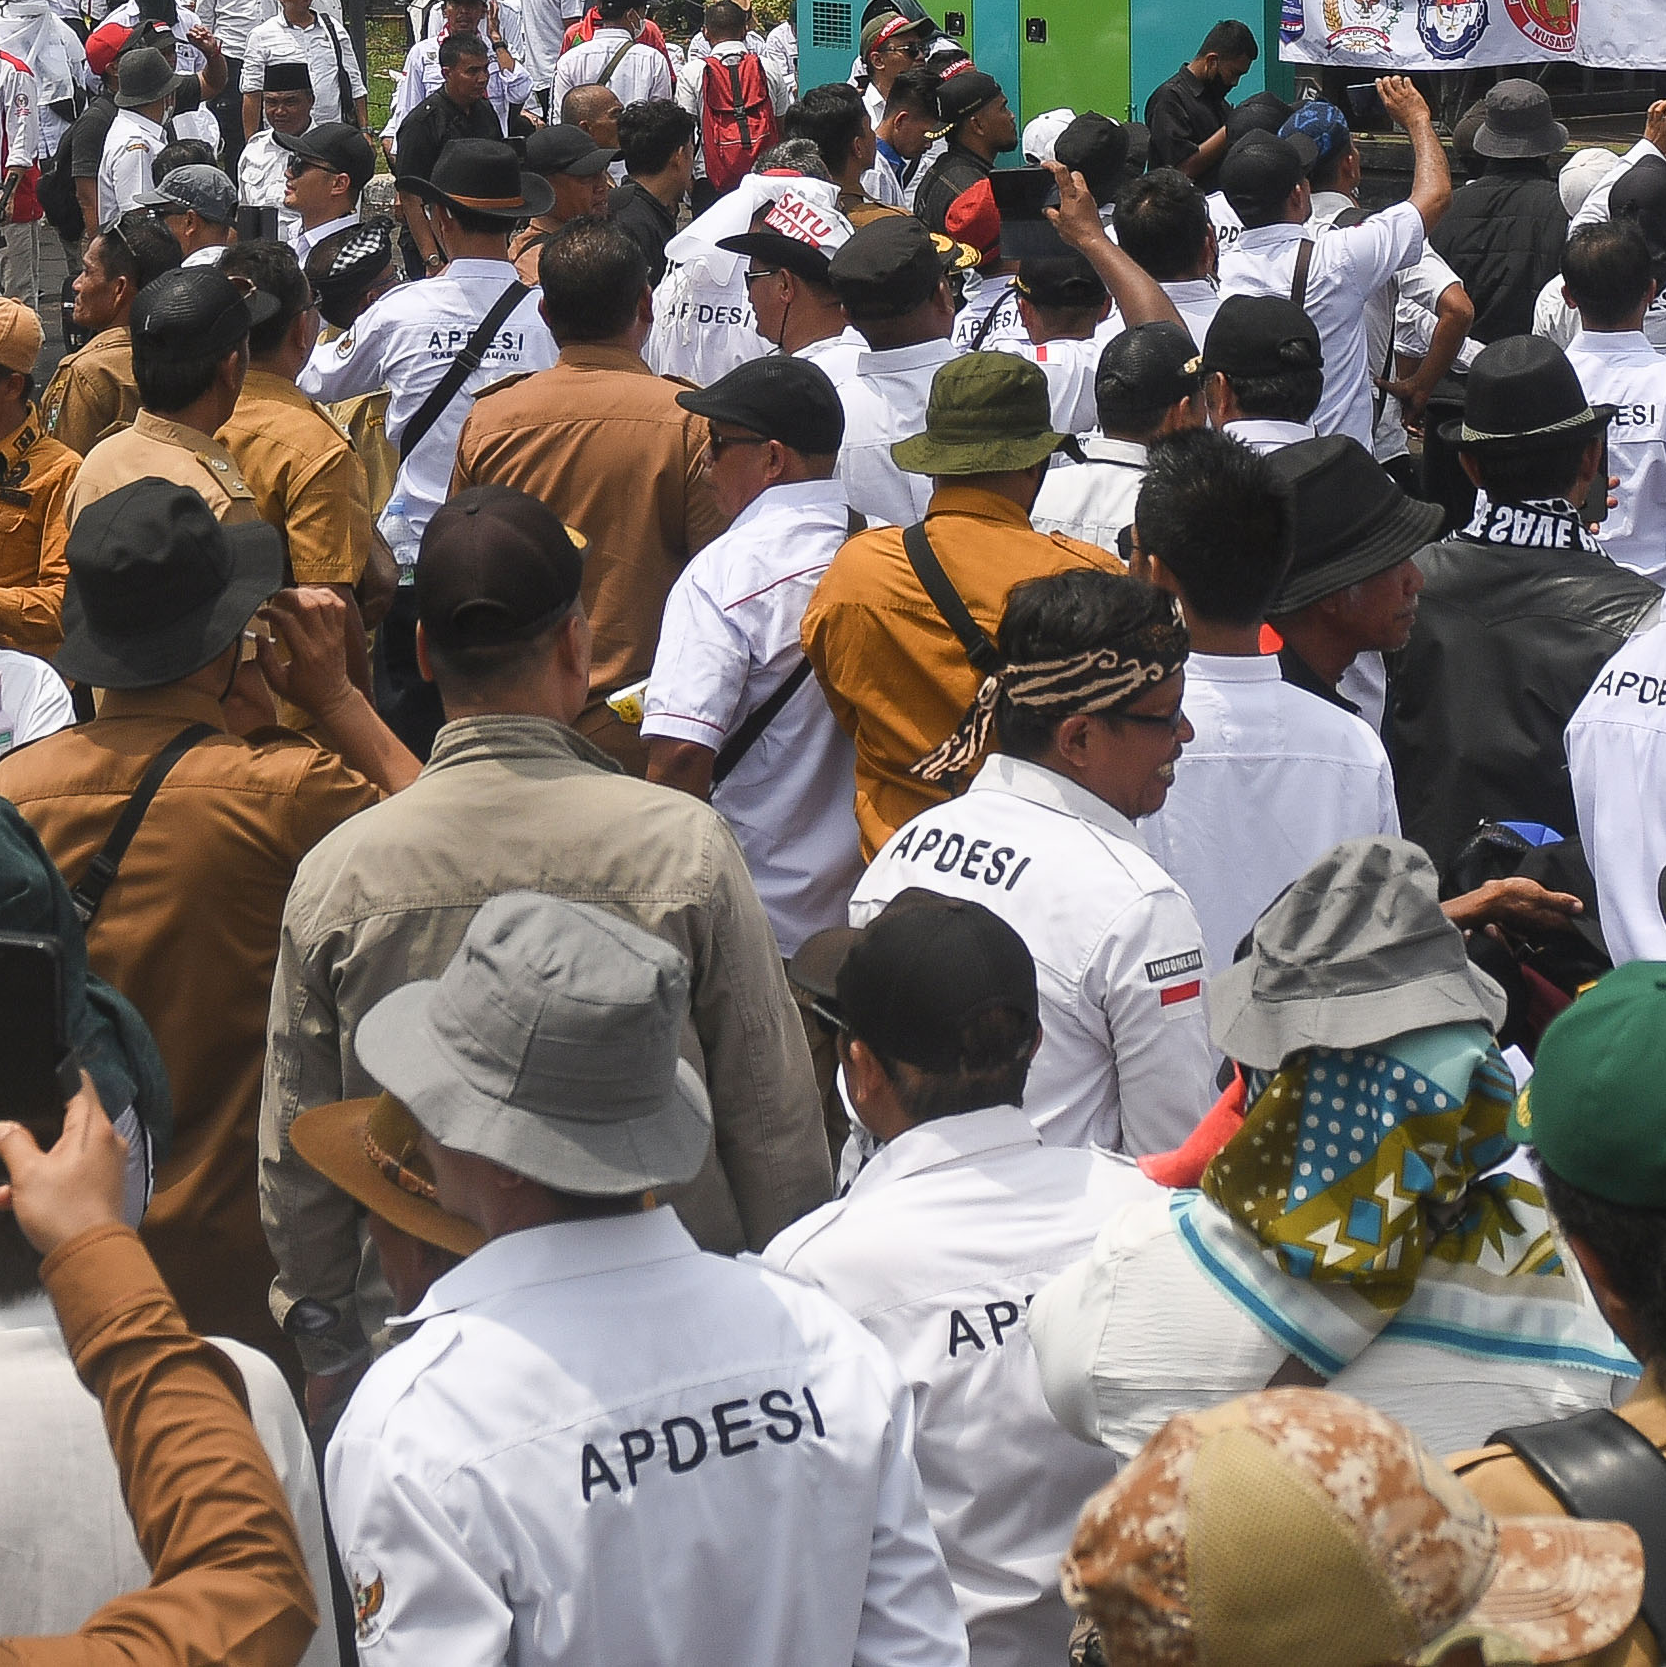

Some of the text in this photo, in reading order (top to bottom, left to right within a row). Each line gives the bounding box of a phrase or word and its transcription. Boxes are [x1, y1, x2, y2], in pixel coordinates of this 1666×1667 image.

[890, 824, 1031, 892] APDESI
[1150, 951, 1201, 978] INDONESIA
[581, 1387, 829, 1502] APDESI
